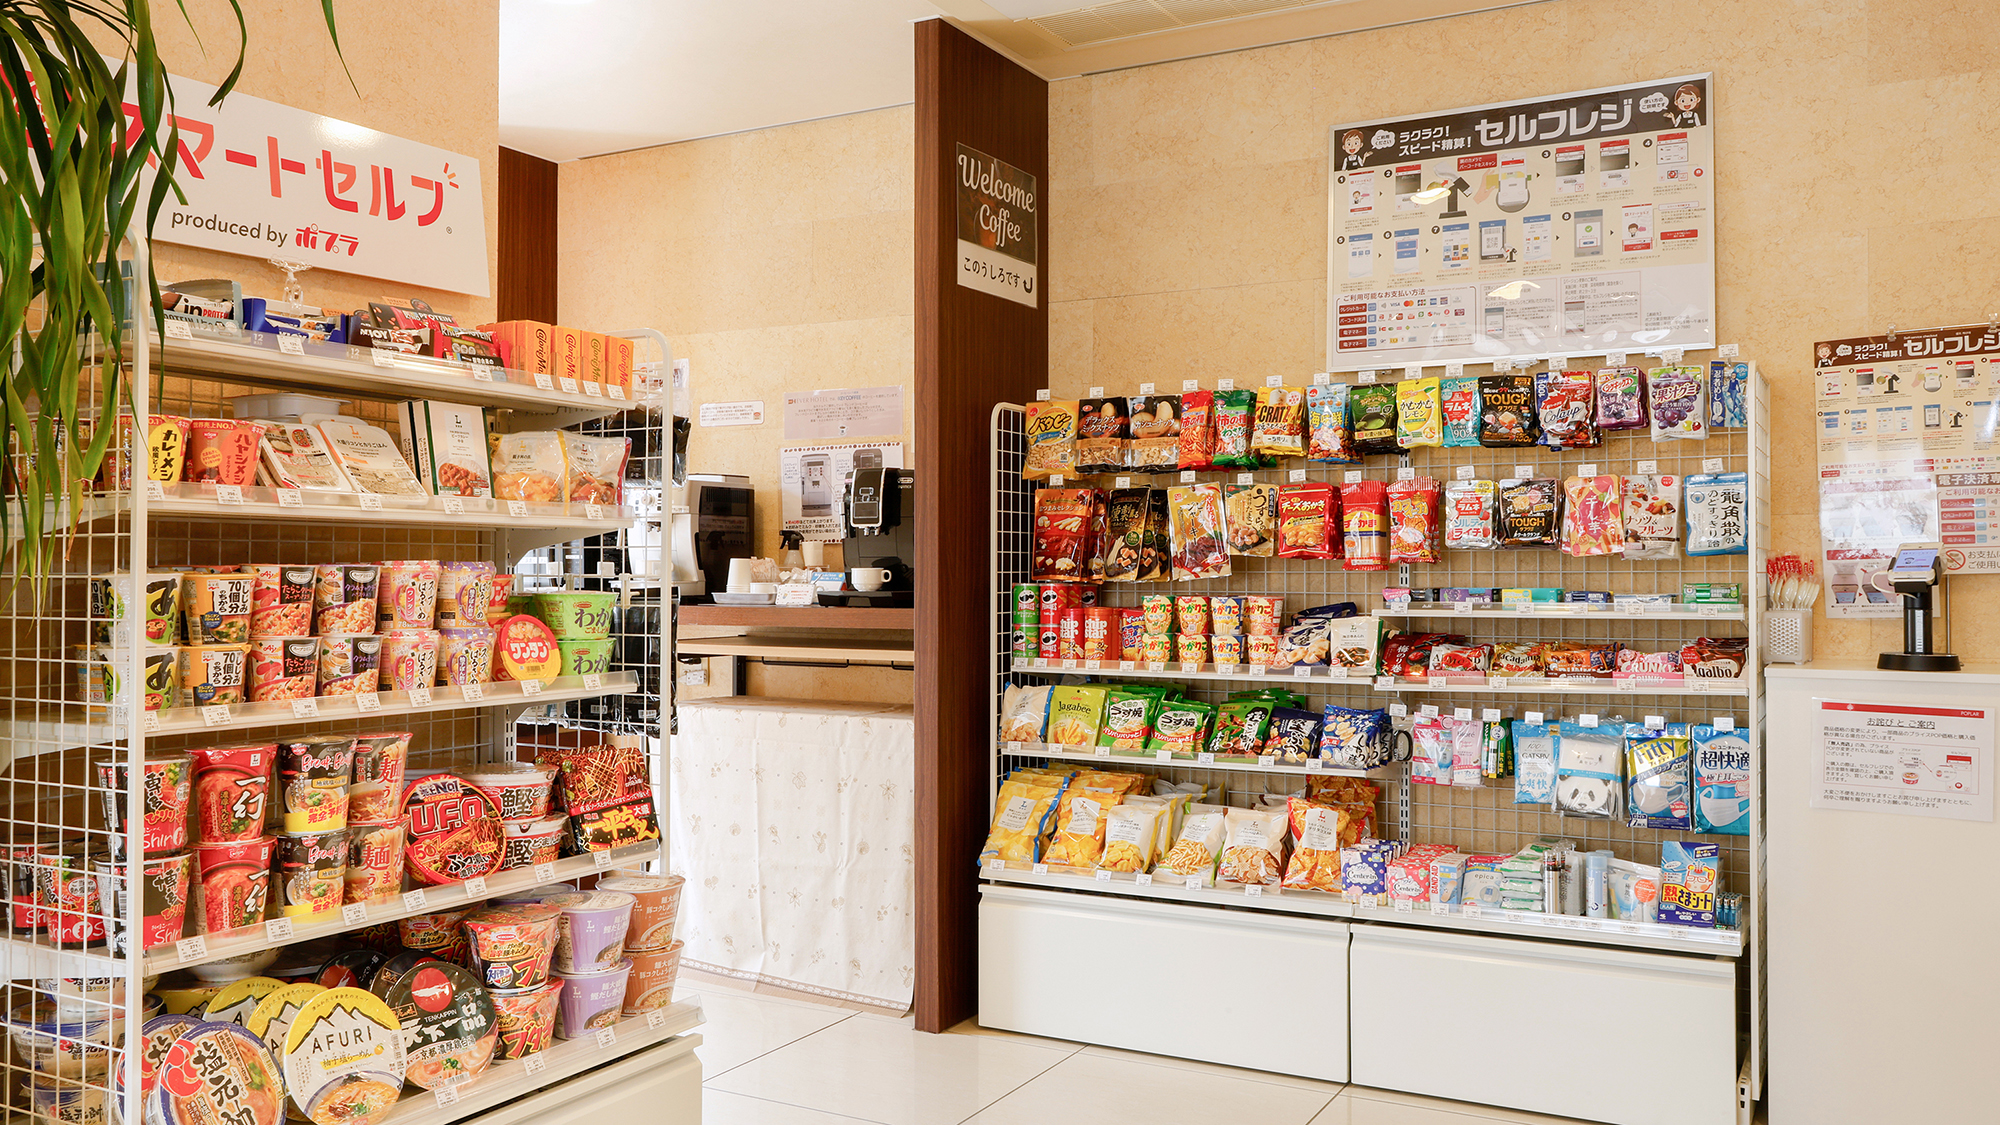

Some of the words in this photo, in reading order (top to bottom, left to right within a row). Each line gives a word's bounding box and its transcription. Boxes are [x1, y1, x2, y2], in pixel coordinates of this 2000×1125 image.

[1474, 98, 1633, 147] セルフレジ
[1399, 125, 1450, 143] ラクラク!
[1399, 136, 1472, 157] スピード精算!
[958, 153, 1035, 213] Welcome
[171, 209, 261, 241] produced
[266, 222, 288, 249] by
[296, 223, 359, 257] ポプラ
[979, 204, 1022, 248] Coffee
[964, 256, 1021, 288] このうしろです
[1343, 288, 1426, 302] ご利用可能なお支払い方法
[184, 297, 203, 316] in
[1854, 343, 1888, 353] ラクラク!
[1854, 350, 1902, 361] スピード精算!
[1483, 393, 1530, 406] TOUGH
[1655, 384, 1697, 403] 果汁グミ
[1258, 405, 1289, 423] CRATZ
[1400, 400, 1434, 411] かむかむ
[1403, 409, 1428, 418] レモン
[1444, 401, 1473, 412] ラムネ
[1082, 424, 1120, 433] ミックスナッツ
[1135, 418, 1175, 429] カシューナッツ
[1181, 416, 1204, 428] 柿の種
[1216, 413, 1247, 426] 柿の種
[160, 429, 178, 482] カレーメシ
[235, 433, 252, 485] ハヤシメシ
[1281, 499, 1326, 512] チーズおかき
[1454, 518, 1485, 527] ソルティ
[1510, 517, 1545, 527] TOUGH
[1707, 489, 1720, 548] のどすっきり飴
[1720, 488, 1744, 544] 龍角散の
[1453, 528, 1482, 539] ライチ
[1638, 526, 1674, 536] フルーツ
[228, 580, 241, 614] 70個分
[406, 588, 415, 618] ワンタン
[510, 641, 548, 659] ワンタン
[223, 652, 235, 685] 70個分
[405, 658, 414, 687] ワンタン
[1058, 701, 1092, 715] Jagabee
[1111, 706, 1143, 718] うす焼
[1161, 715, 1196, 727] うす焼
[1867, 717, 1893, 726] お詫び
[1908, 720, 1936, 729] ご案内
[1633, 740, 1676, 764] Fitty
[1700, 750, 1749, 771] 超快適
[301, 754, 332, 772] Break
[1526, 779, 1548, 790] 爽快
[233, 776, 267, 820] 一幻
[581, 805, 660, 841] 一平ちゃん
[308, 845, 334, 864] Break
[1663, 884, 1713, 910] 熱さまシート
[423, 1009, 458, 1023] TENKAIPPIN
[312, 1026, 373, 1054] AFURI
[322, 1047, 373, 1069] 柚子塩らーめん
